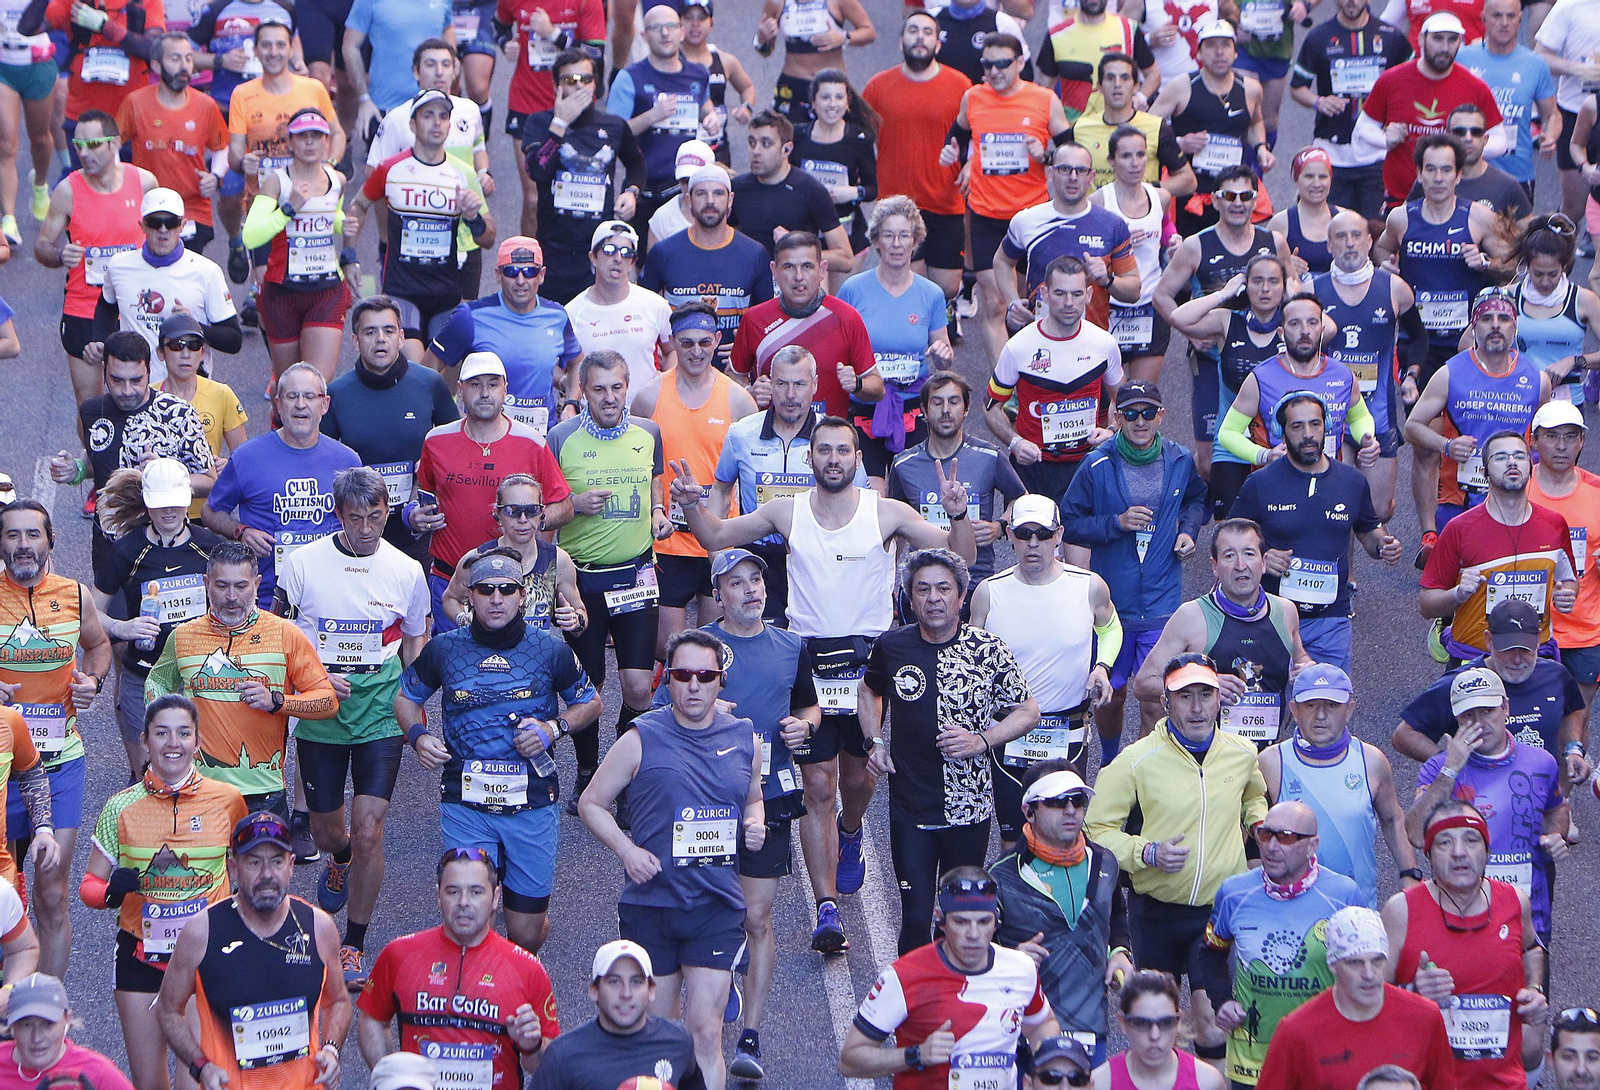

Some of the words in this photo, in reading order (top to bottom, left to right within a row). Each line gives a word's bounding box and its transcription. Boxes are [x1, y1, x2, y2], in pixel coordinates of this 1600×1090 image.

[996, 134, 1023, 142] ZURICH
[1212, 135, 1238, 146] ZURICH
[273, 159, 295, 167] ZURIC
[814, 162, 843, 173] ZURICH
[572, 175, 602, 185] ZURICH
[419, 222, 447, 232] ZURICH
[306, 237, 331, 247] ZURICH
[415, 236, 440, 244] 13725
[102, 246, 131, 257] ZURICH
[1433, 292, 1463, 302] ZURICH
[592, 330, 608, 340] Grup
[631, 326, 644, 334] TMB
[1345, 330, 1360, 349] B
[883, 352, 914, 362] ZURICH
[1343, 353, 1374, 364] ZURICH
[517, 397, 543, 407] ZURICH
[1469, 390, 1522, 403] FUNDACIÓN
[1059, 400, 1090, 413] ZURICH
[1455, 400, 1485, 411] JOSEP
[1486, 401, 1532, 415] CARRERAS
[513, 414, 535, 424] 8814
[1058, 418, 1084, 430] 10314
[1053, 429, 1089, 441] JEAN-MARC
[375, 464, 407, 475] ZURICH
[600, 468, 620, 476] MEDIO
[620, 464, 647, 474] MARATÓN
[587, 478, 602, 487] DE
[605, 475, 649, 486] SEVILLA
[775, 475, 809, 485] ZURICH
[287, 480, 317, 498] CLUB
[273, 492, 335, 514] ATLETISMO
[282, 509, 325, 526] ORIPPO
[295, 532, 327, 544] ZURICH
[344, 565, 370, 575] diapelo
[1303, 562, 1334, 573] ZURICH
[162, 577, 198, 591] ZURICH
[1297, 578, 1325, 590] 14107
[1507, 573, 1541, 584] ZURICH
[611, 597, 621, 605] TE
[621, 591, 645, 603] QUIERO
[646, 589, 657, 599] ANA
[161, 597, 192, 609] 11315
[167, 610, 188, 621] EMILY
[339, 622, 375, 632] ZURICH
[338, 641, 363, 652] 9366
[336, 654, 362, 663] ZOLTAN
[837, 670, 860, 680] RICH
[820, 687, 850, 697] 10118
[827, 698, 838, 707] NO
[1242, 695, 1275, 706] ZURICH
[25, 707, 61, 717] ZURICH
[1037, 719, 1062, 728] RICH
[1242, 715, 1265, 726] 6766
[30, 726, 49, 737] 158
[1237, 729, 1266, 739] ANTONIO
[1023, 734, 1052, 745] 12552
[1023, 748, 1048, 759] SERGIO
[484, 761, 520, 773] ZURICH
[483, 782, 509, 793] 9102
[483, 795, 507, 805] JORGE
[696, 808, 731, 820] ZURICH
[695, 830, 719, 842] 9004
[688, 846, 697, 855] EL
[698, 844, 725, 855] ORTEGA
[1490, 852, 1526, 863] ZURICH
[162, 902, 202, 917] ZURICH
[1250, 973, 1321, 992] VENTURA
[416, 990, 447, 1012] Bar
[453, 994, 500, 1020] Colón
[1462, 996, 1503, 1009] ZURICH
[256, 1003, 299, 1018] ZURICH
[256, 1025, 292, 1042] 10942
[442, 1048, 485, 1060] ZURICH
[974, 1055, 1008, 1068] ZURICH
[438, 1071, 474, 1083] 10080
[973, 1079, 999, 1090] 9420
